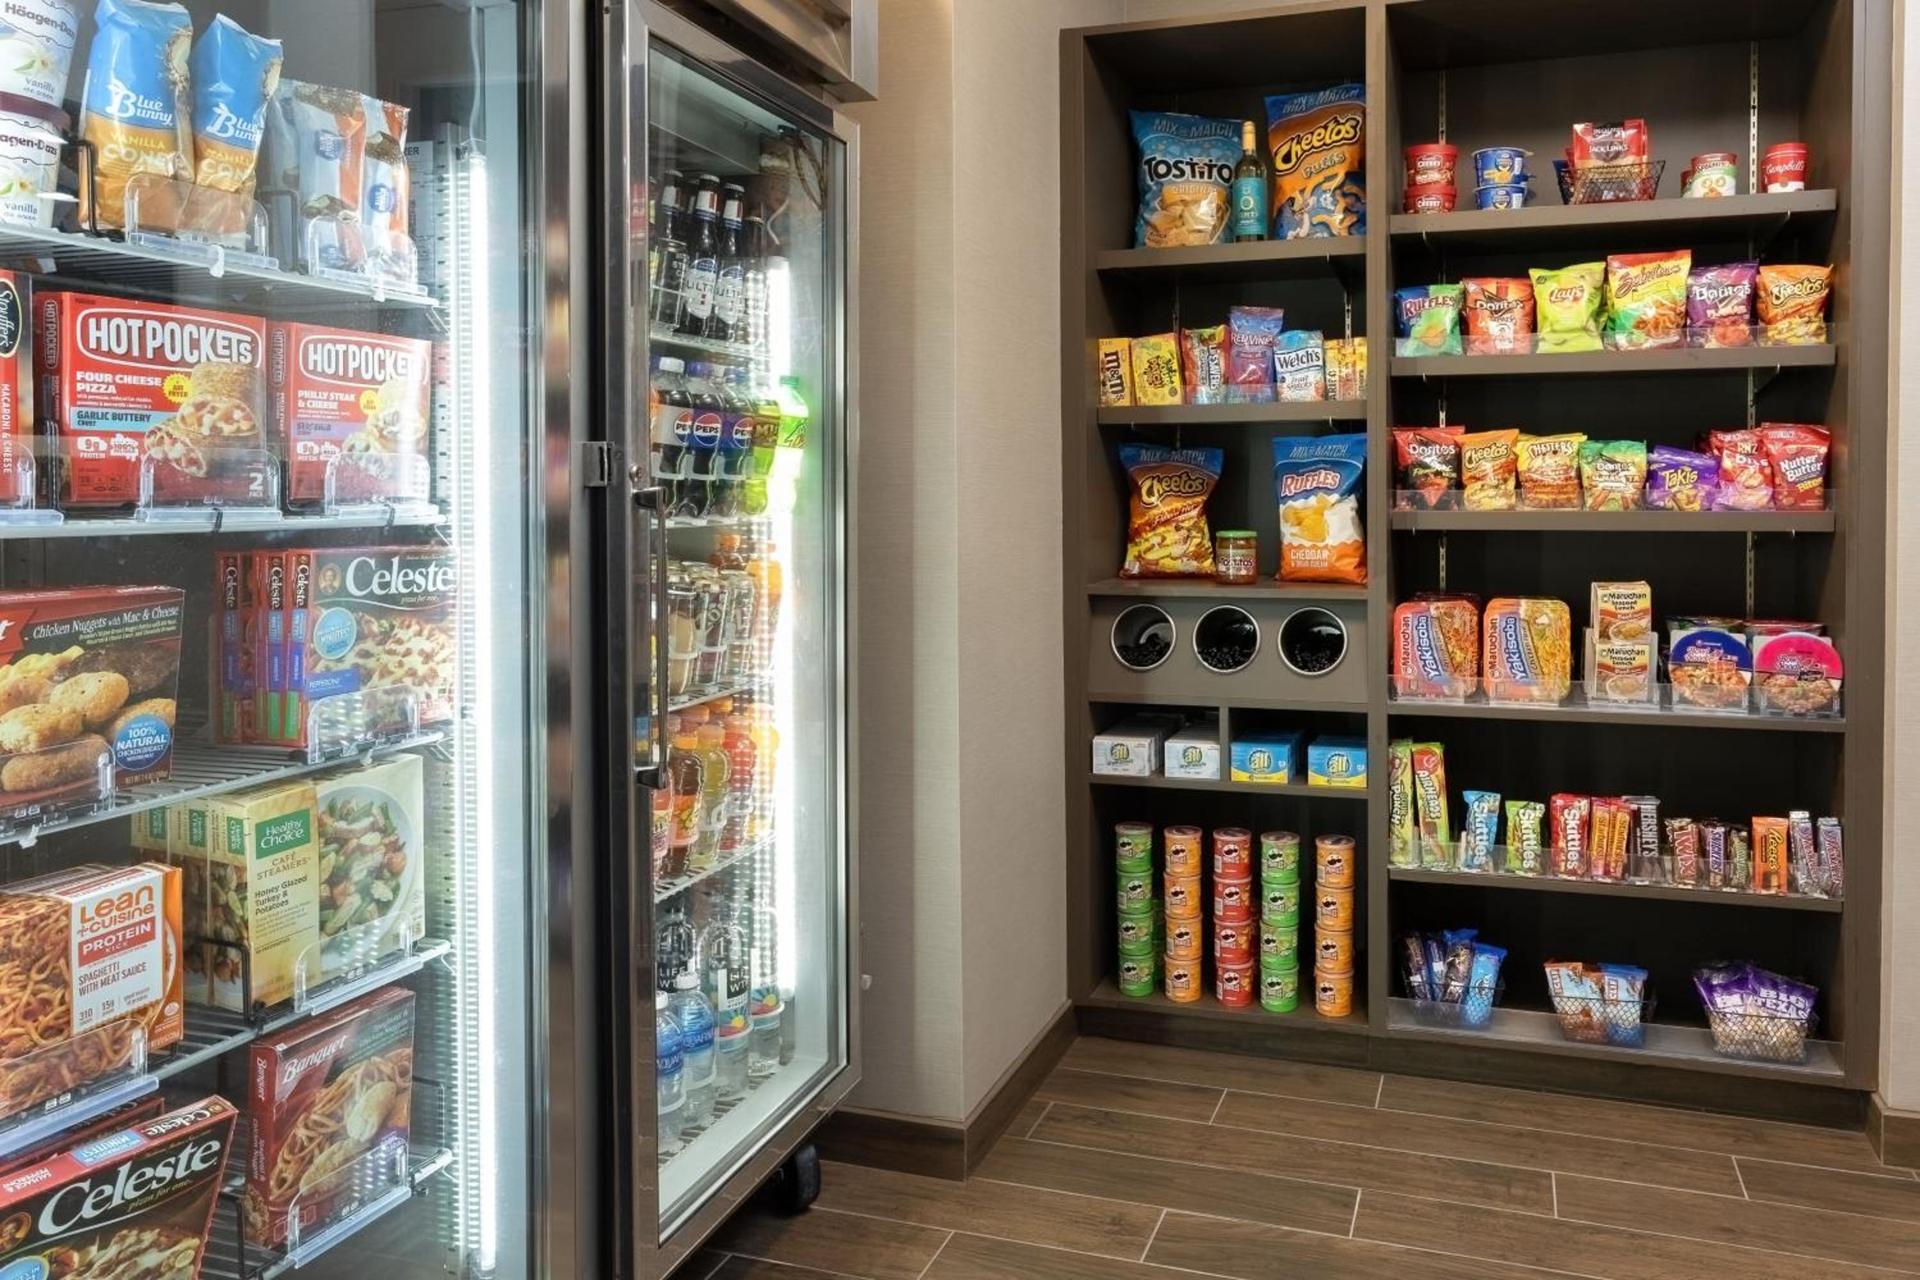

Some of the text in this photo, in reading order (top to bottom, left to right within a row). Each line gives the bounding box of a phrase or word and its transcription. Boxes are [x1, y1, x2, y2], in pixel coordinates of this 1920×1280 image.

[105, 79, 163, 118] Blue
[1154, 119, 1234, 139] MIX MATCH
[1275, 116, 1362, 172] Cheetos
[1143, 156, 1234, 186] TOSTITO
[1765, 159, 1806, 175] Campbell's
[1770, 278, 1825, 307] Cheetos
[1403, 295, 1456, 318] RUFFLES
[1475, 300, 1525, 312] Doritos
[1279, 350, 1320, 370] Welch's
[76, 371, 162, 386] FOUR CHEESE
[76, 382, 117, 394] PIZZA
[298, 390, 355, 402] PHILLY STEAK
[307, 401, 339, 410] CHEESE
[1, 383, 12, 473] MACARONI & CHEESE
[77, 410, 152, 423] GARLIC BUTTERY
[695, 424, 720, 435] PEPS
[1289, 444, 1348, 458] MIX MATCH
[1409, 443, 1456, 457] Doritos
[1464, 443, 1511, 470] Cheetos
[1780, 454, 1819, 472] Nutter
[1786, 463, 1824, 482] Butter
[249, 472, 264, 492] 2
[1141, 472, 1206, 506] Cheetos
[1283, 471, 1341, 497] RUFFLES
[1662, 469, 1699, 490] Takis
[1291, 550, 1329, 561] CHEDDAR
[296, 564, 309, 607] Celeste
[346, 556, 459, 596] Celeste
[271, 567, 283, 609] Celeste
[1608, 592, 1647, 601] Maruchan
[33, 623, 70, 640] Chicken
[72, 618, 107, 634] Nuggets
[122, 611, 141, 624] Mac
[142, 608, 150, 619] &
[152, 606, 179, 619] Cheese
[1402, 616, 1412, 667] Maruchan
[1415, 614, 1443, 682] Yakisoba
[1488, 618, 1499, 670] Maruchan
[1503, 616, 1530, 681] Yakisoba
[1606, 648, 1646, 657] Maruchan
[117, 735, 167, 750] NATURAL
[129, 727, 157, 738] 100%
[1110, 744, 1129, 761] all
[1183, 747, 1202, 765] all
[1250, 752, 1269, 770] all
[1327, 755, 1348, 773] all
[1391, 784, 1402, 827] PUNCH
[1416, 769, 1442, 819] AIRHEADS
[261, 829, 305, 849] Choice
[266, 819, 302, 837] Healthy
[1472, 801, 1489, 866] Skittles
[1520, 808, 1538, 869] Skittles
[1563, 808, 1583, 870] Skittles
[1640, 804, 1659, 858] HERSHEY'S
[1709, 826, 1725, 874] SNICKERS
[257, 858, 308, 880] STEAMERS
[255, 874, 308, 899] Honey Glazed
[80, 885, 154, 924] Lean
[256, 894, 280, 907] Turkey
[256, 900, 289, 916] Potatoes
[82, 922, 153, 956] PROTEIN
[79, 961, 120, 985] SPAGHETTI
[79, 961, 147, 998] WITH MEAT SAUCE
[660, 966, 686, 977] LIFE
[1551, 969, 1563, 992] CLIF
[1608, 978, 1619, 1003] CLIF
[1760, 987, 1806, 1008] BIG
[80, 1008, 93, 1021] 310
[281, 1034, 347, 1085] Banquet
[146, 1108, 211, 1136] Celeste
[38, 1140, 221, 1236] Celeste
